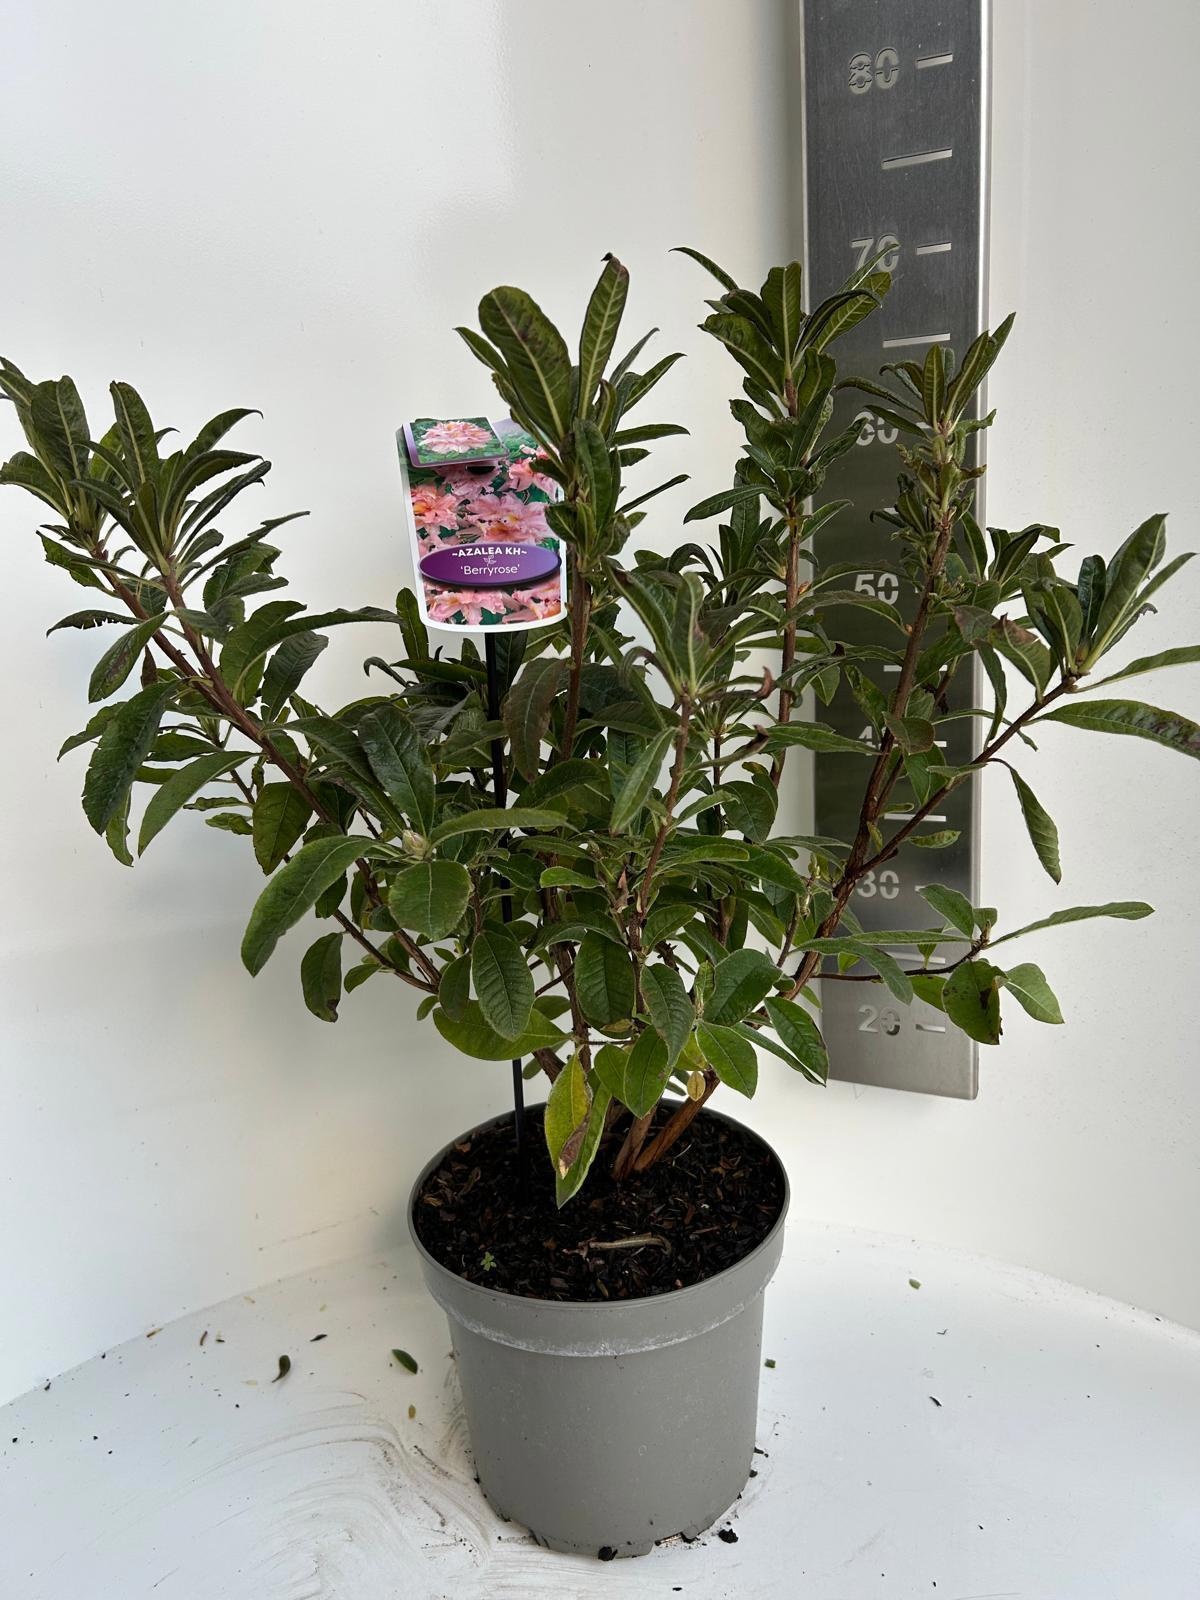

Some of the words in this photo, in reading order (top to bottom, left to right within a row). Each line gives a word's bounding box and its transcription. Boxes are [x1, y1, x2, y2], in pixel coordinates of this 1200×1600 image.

[849, 47, 899, 94] 80
[851, 234, 899, 272] 70
[854, 573, 899, 605] 50
[857, 870, 900, 899] 30
[858, 1004, 900, 1036] 20
